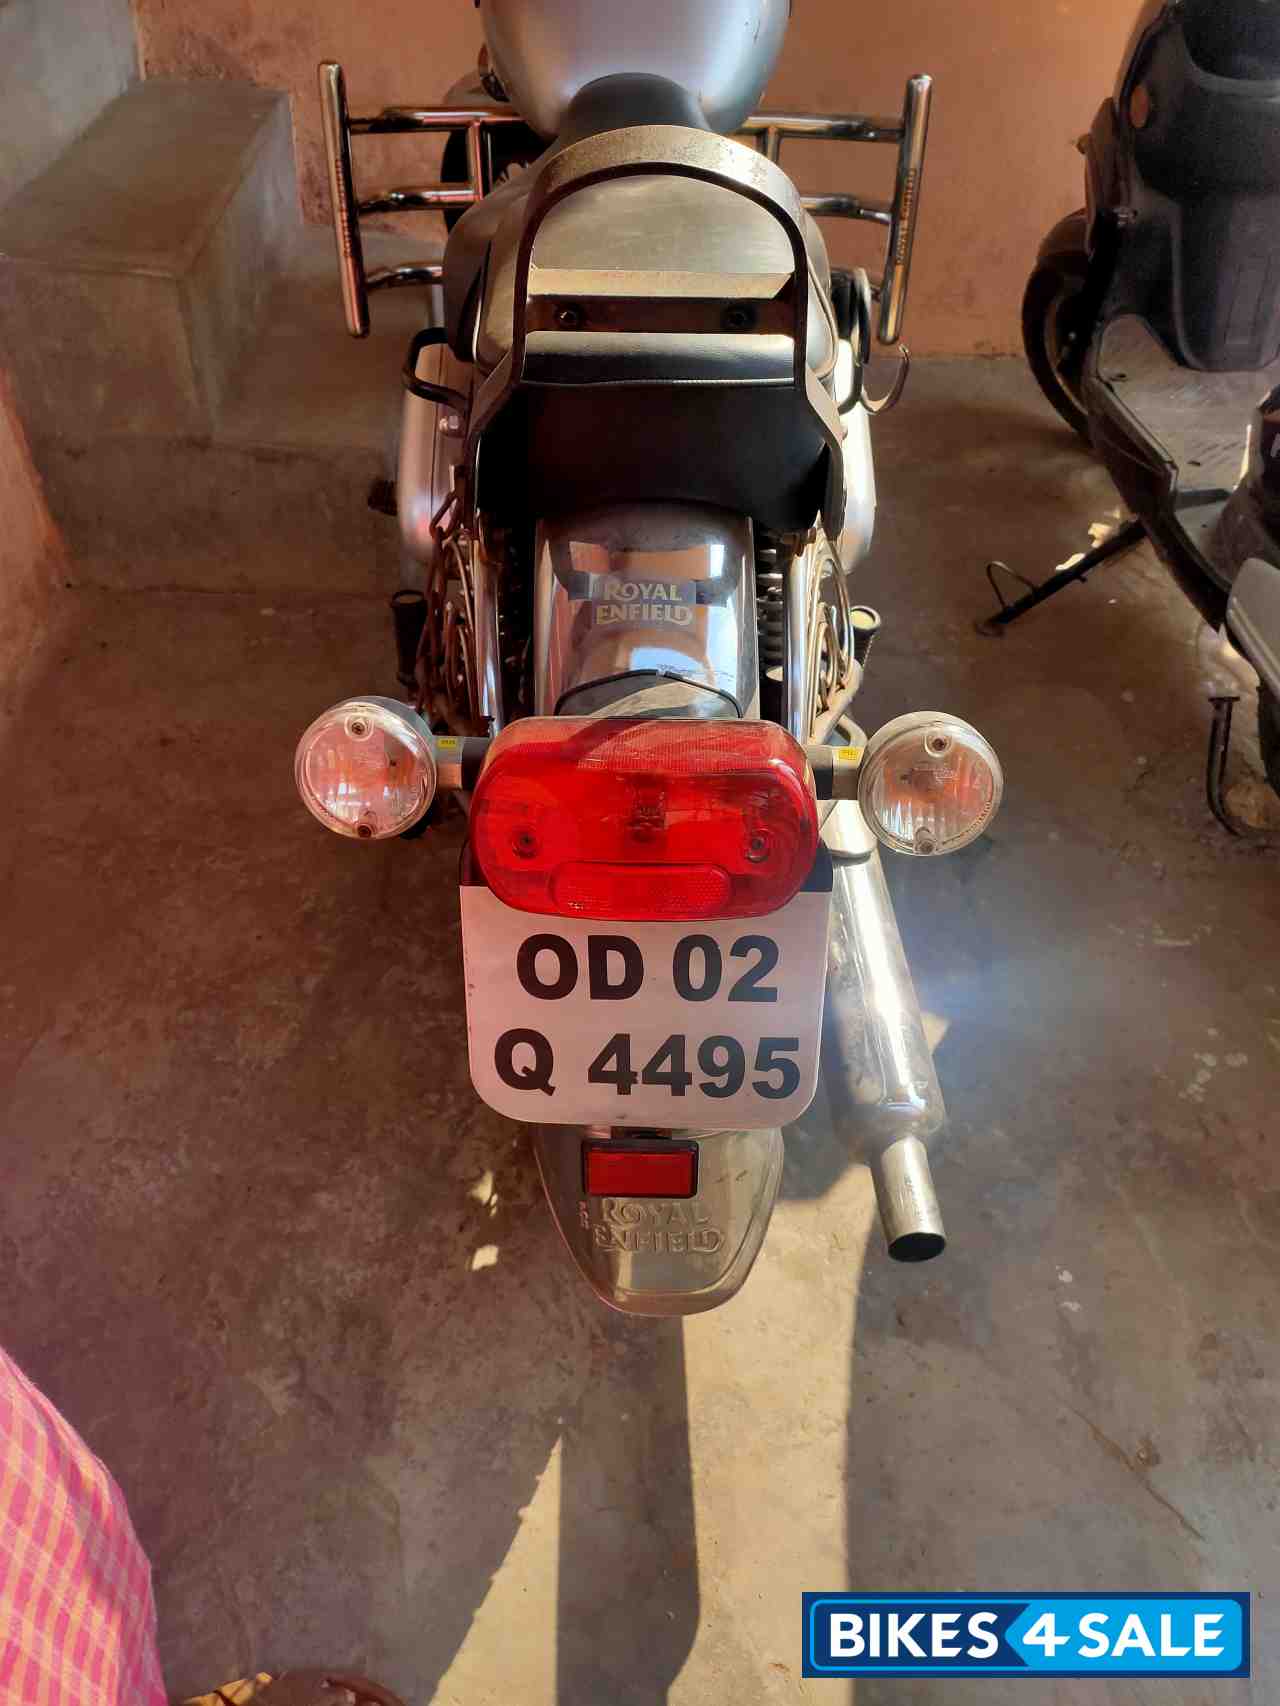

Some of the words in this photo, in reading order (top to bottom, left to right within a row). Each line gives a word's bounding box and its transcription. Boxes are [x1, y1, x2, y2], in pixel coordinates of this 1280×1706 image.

[605, 583, 682, 601] ROYAL
[596, 603, 693, 626] ENFIELD
[516, 933, 644, 1001] OD
[672, 934, 780, 1002] 02
[494, 1028, 556, 1097] Q
[587, 1033, 801, 1099] 4495
[602, 1199, 710, 1231] ROYAL
[593, 1224, 725, 1253] ENFIELD
